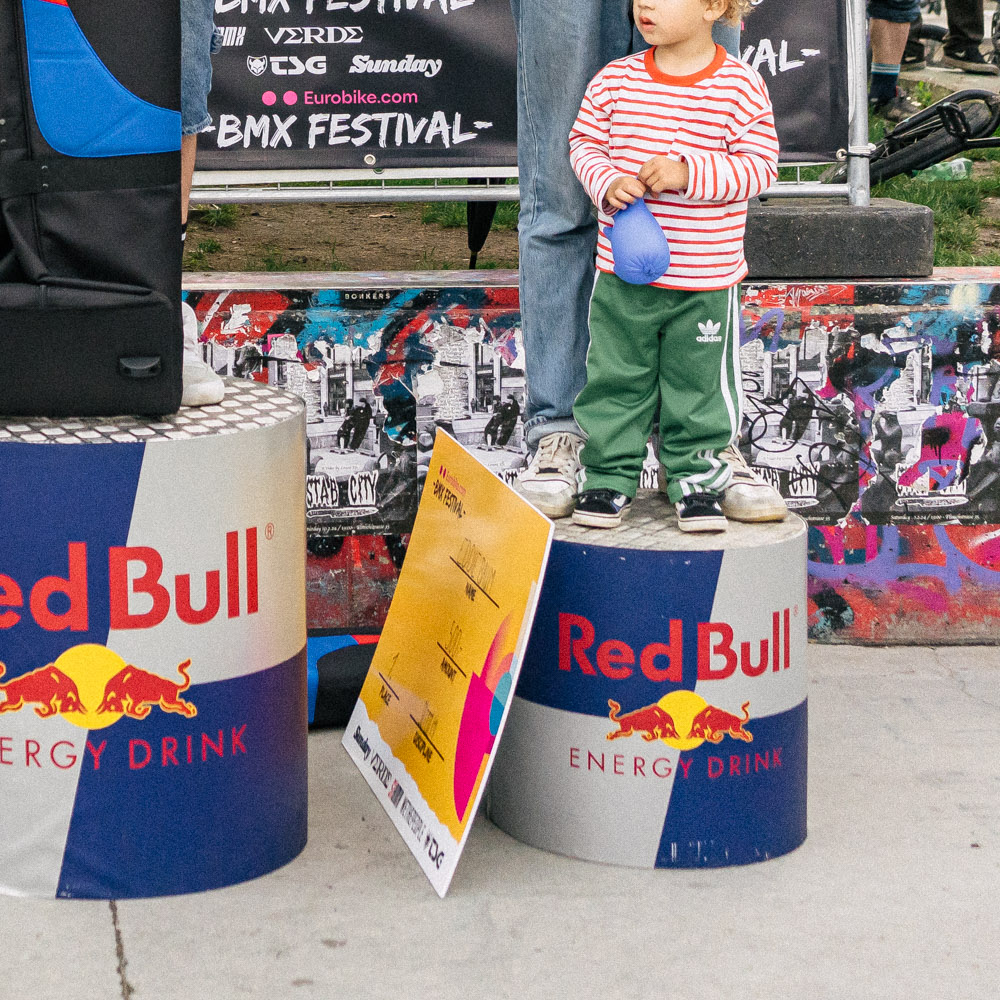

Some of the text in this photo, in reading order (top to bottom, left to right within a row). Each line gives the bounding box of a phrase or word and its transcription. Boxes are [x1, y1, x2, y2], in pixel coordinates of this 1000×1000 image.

[270, 54, 443, 78] TSG Sunday
[303, 90, 418, 105] Eurobike.com
[696, 334, 722, 342] adidas
[350, 472, 377, 504] CITY
[108, 526, 260, 631] Bull
[558, 607, 791, 683] Red Bull
[128, 723, 248, 770] DRINK
[569, 747, 783, 779] ENERGY DRINK
